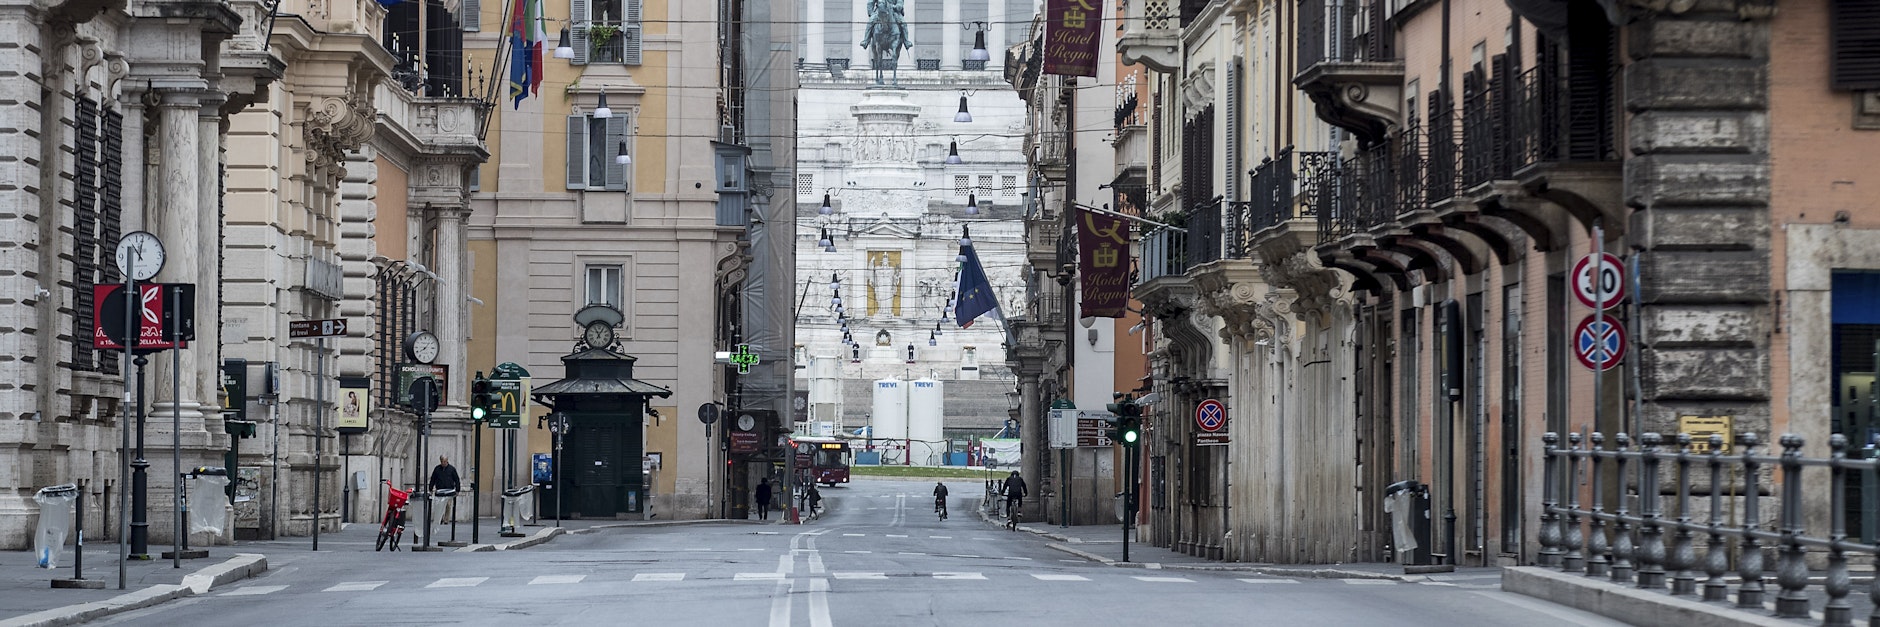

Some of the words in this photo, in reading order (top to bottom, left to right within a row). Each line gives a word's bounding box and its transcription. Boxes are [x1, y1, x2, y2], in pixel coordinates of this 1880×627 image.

[1051, 30, 1095, 44] Hotel
[1048, 44, 1094, 63] Regno
[118, 253, 124, 261] 9
[157, 252, 162, 260] 3
[138, 270, 144, 278] 6
[1085, 271, 1126, 286] Hotel
[1083, 286, 1127, 305] Regno
